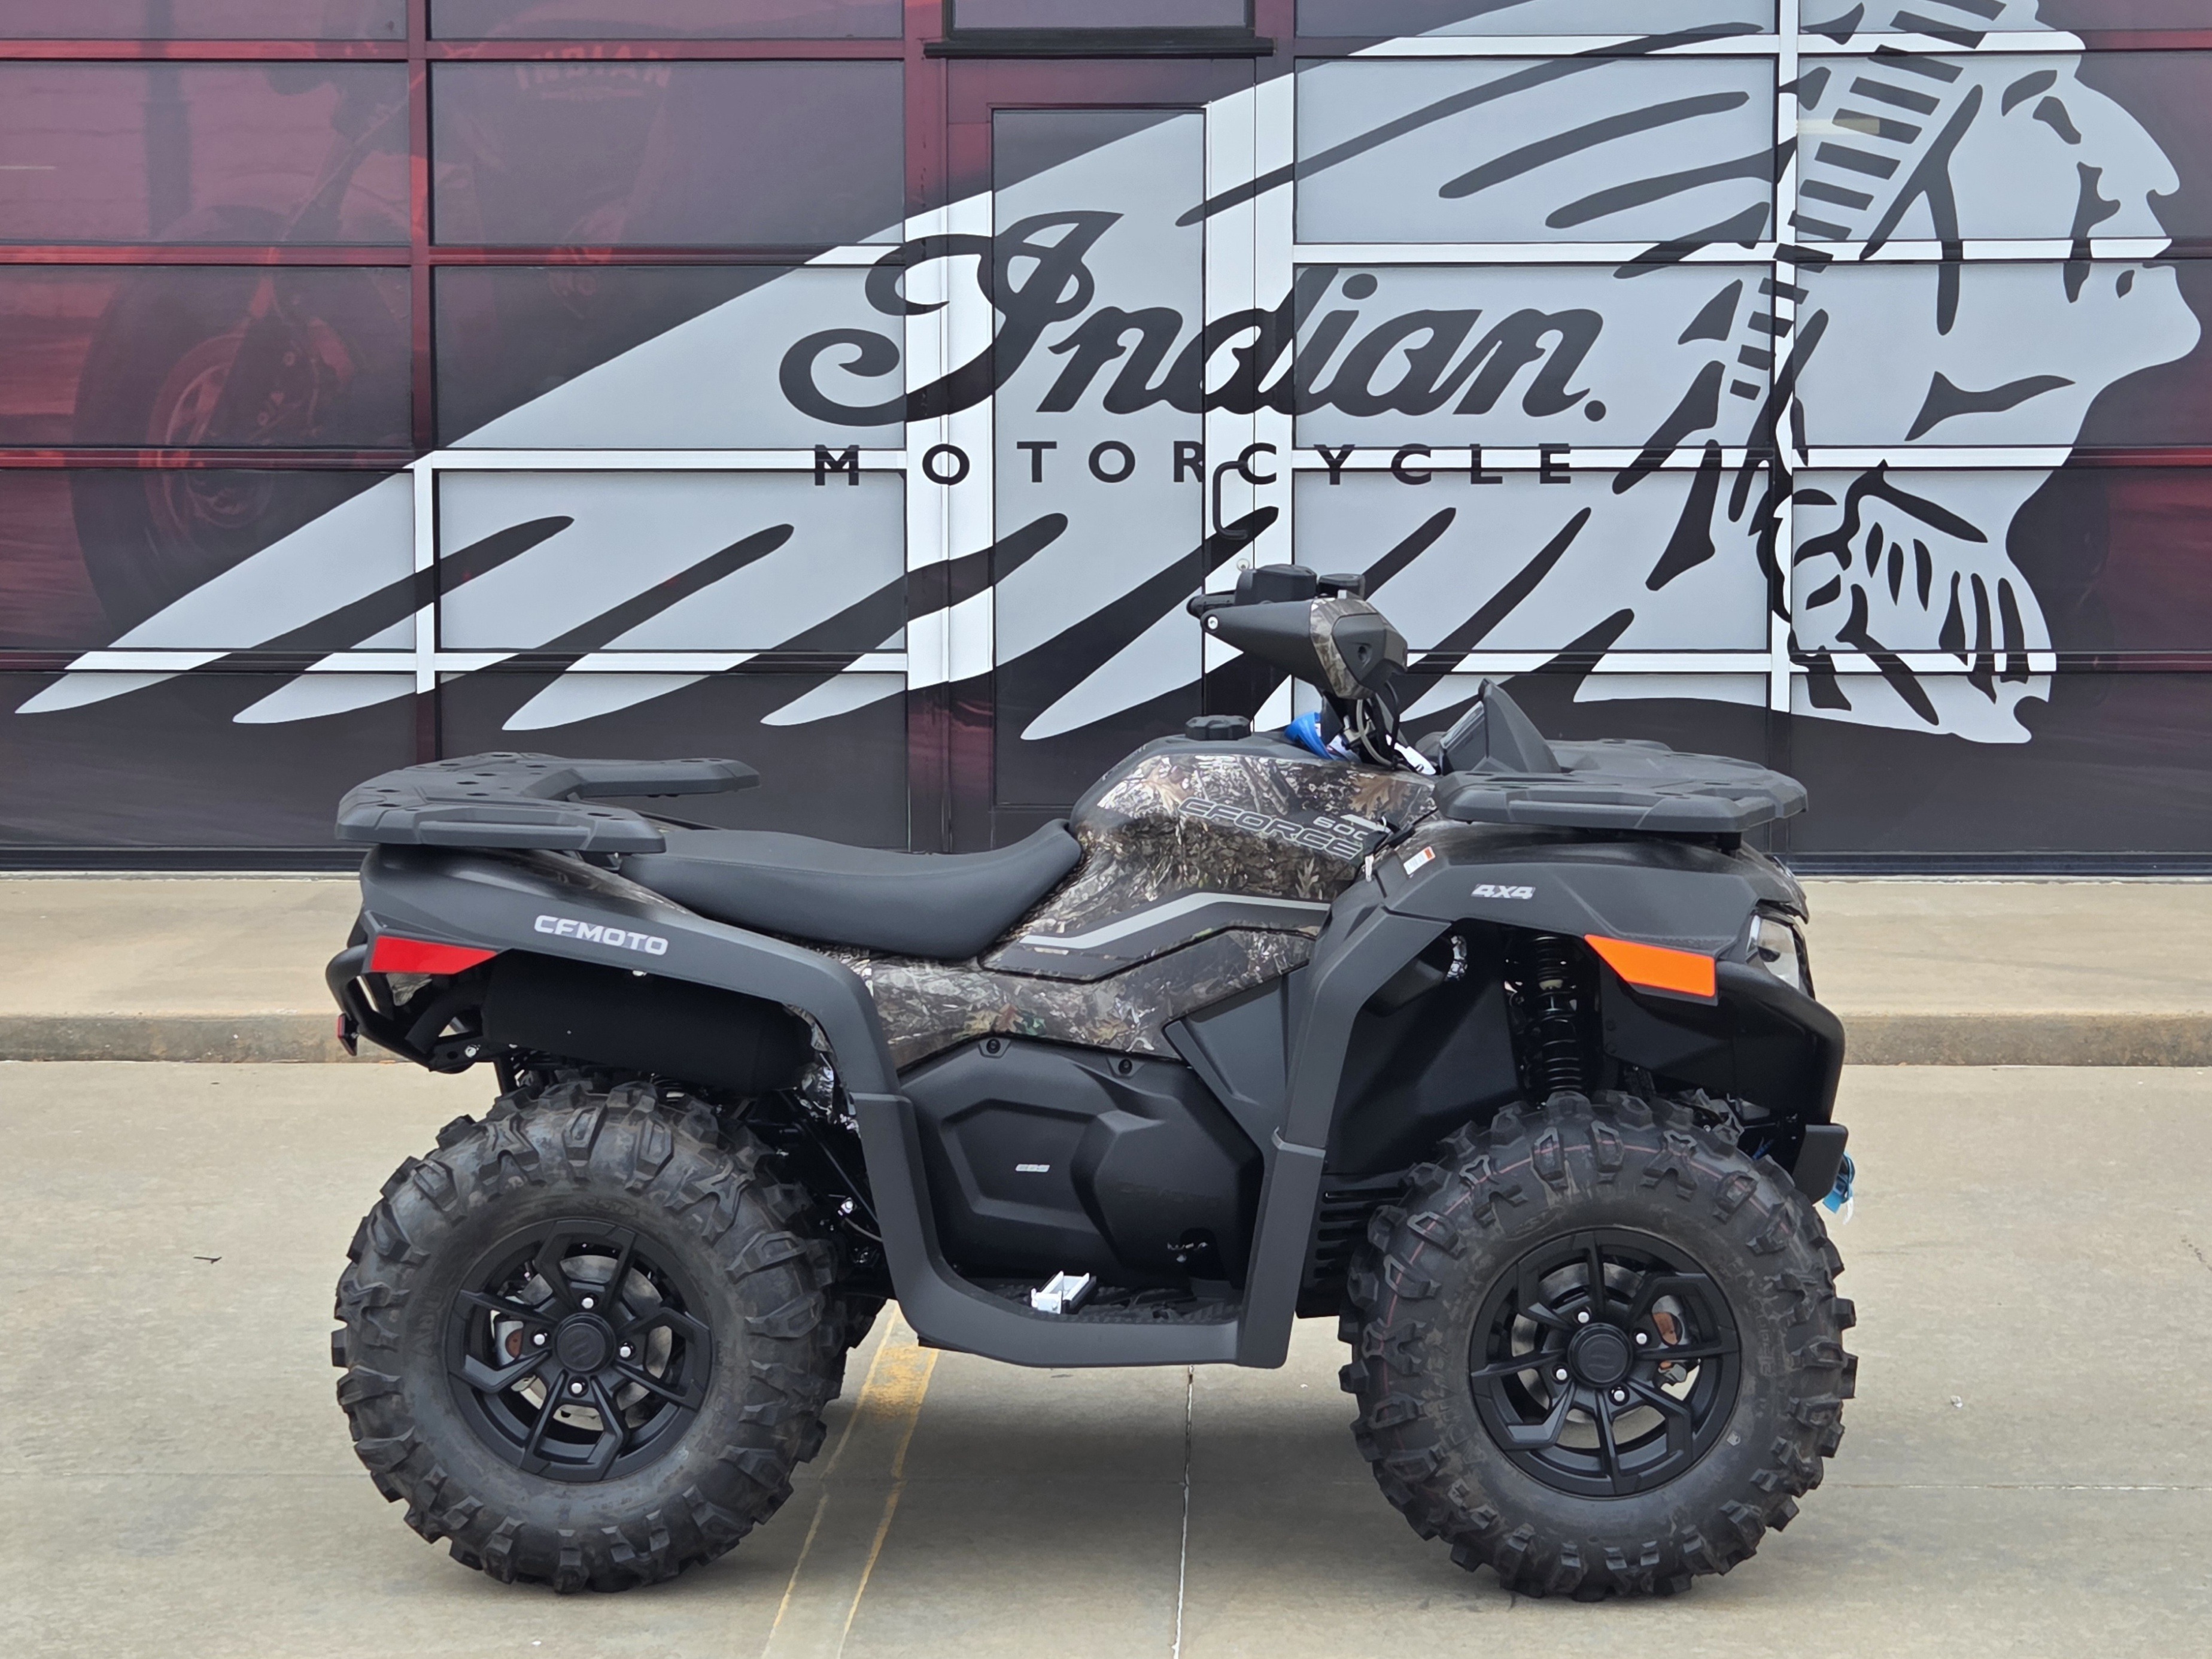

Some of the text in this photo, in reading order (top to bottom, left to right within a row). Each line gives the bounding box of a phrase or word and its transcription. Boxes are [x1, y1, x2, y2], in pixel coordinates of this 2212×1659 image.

[814, 441, 1572, 486] MOTORCYCLE
[1178, 797, 1363, 860] CFORCE
[534, 915, 669, 955] CFMOTO
